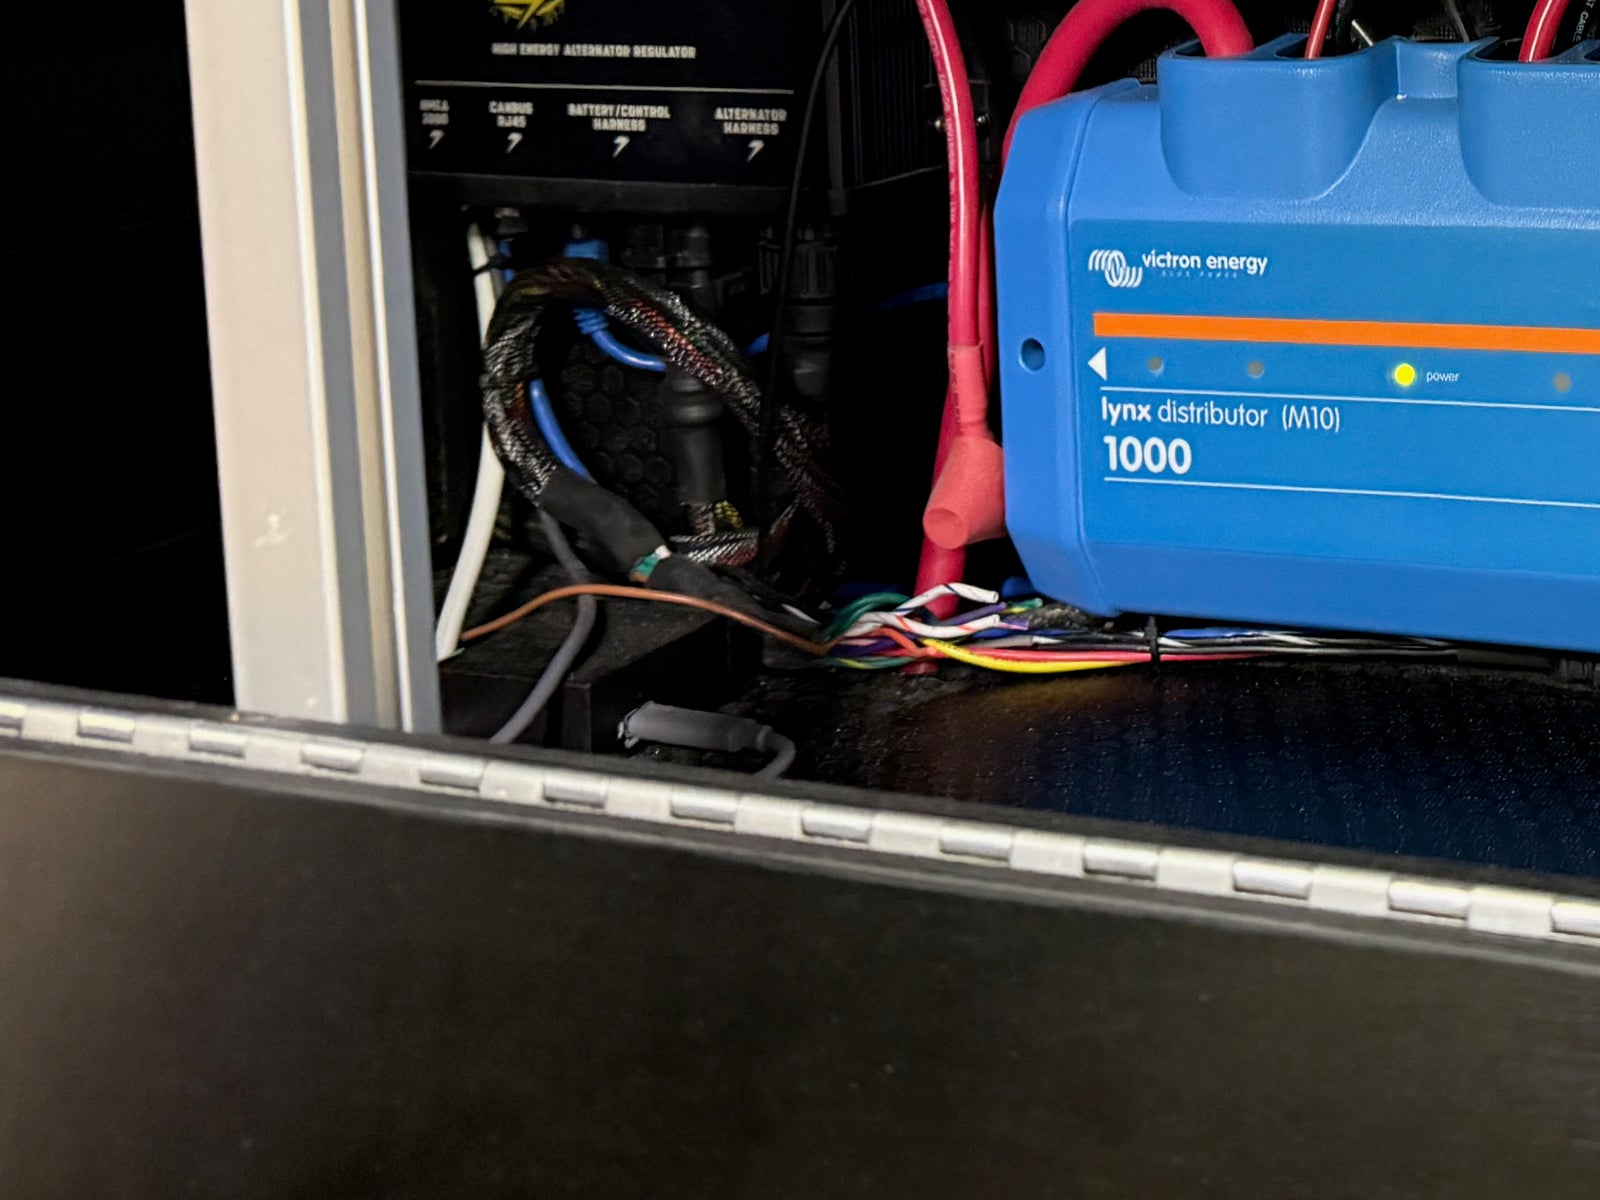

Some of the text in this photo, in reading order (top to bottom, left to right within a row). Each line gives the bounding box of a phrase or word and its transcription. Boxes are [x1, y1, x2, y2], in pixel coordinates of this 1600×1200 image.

[563, 44, 630, 58] ALTERNATOR
[632, 45, 696, 60] REGULATOR
[714, 106, 787, 123] ALTERNATOR
[723, 121, 779, 136] HARNESS
[1142, 249, 1268, 276] victron energy
[1426, 370, 1460, 384] power
[1101, 395, 1341, 434] lynx distributor (M10)
[1103, 435, 1192, 475] 1000
